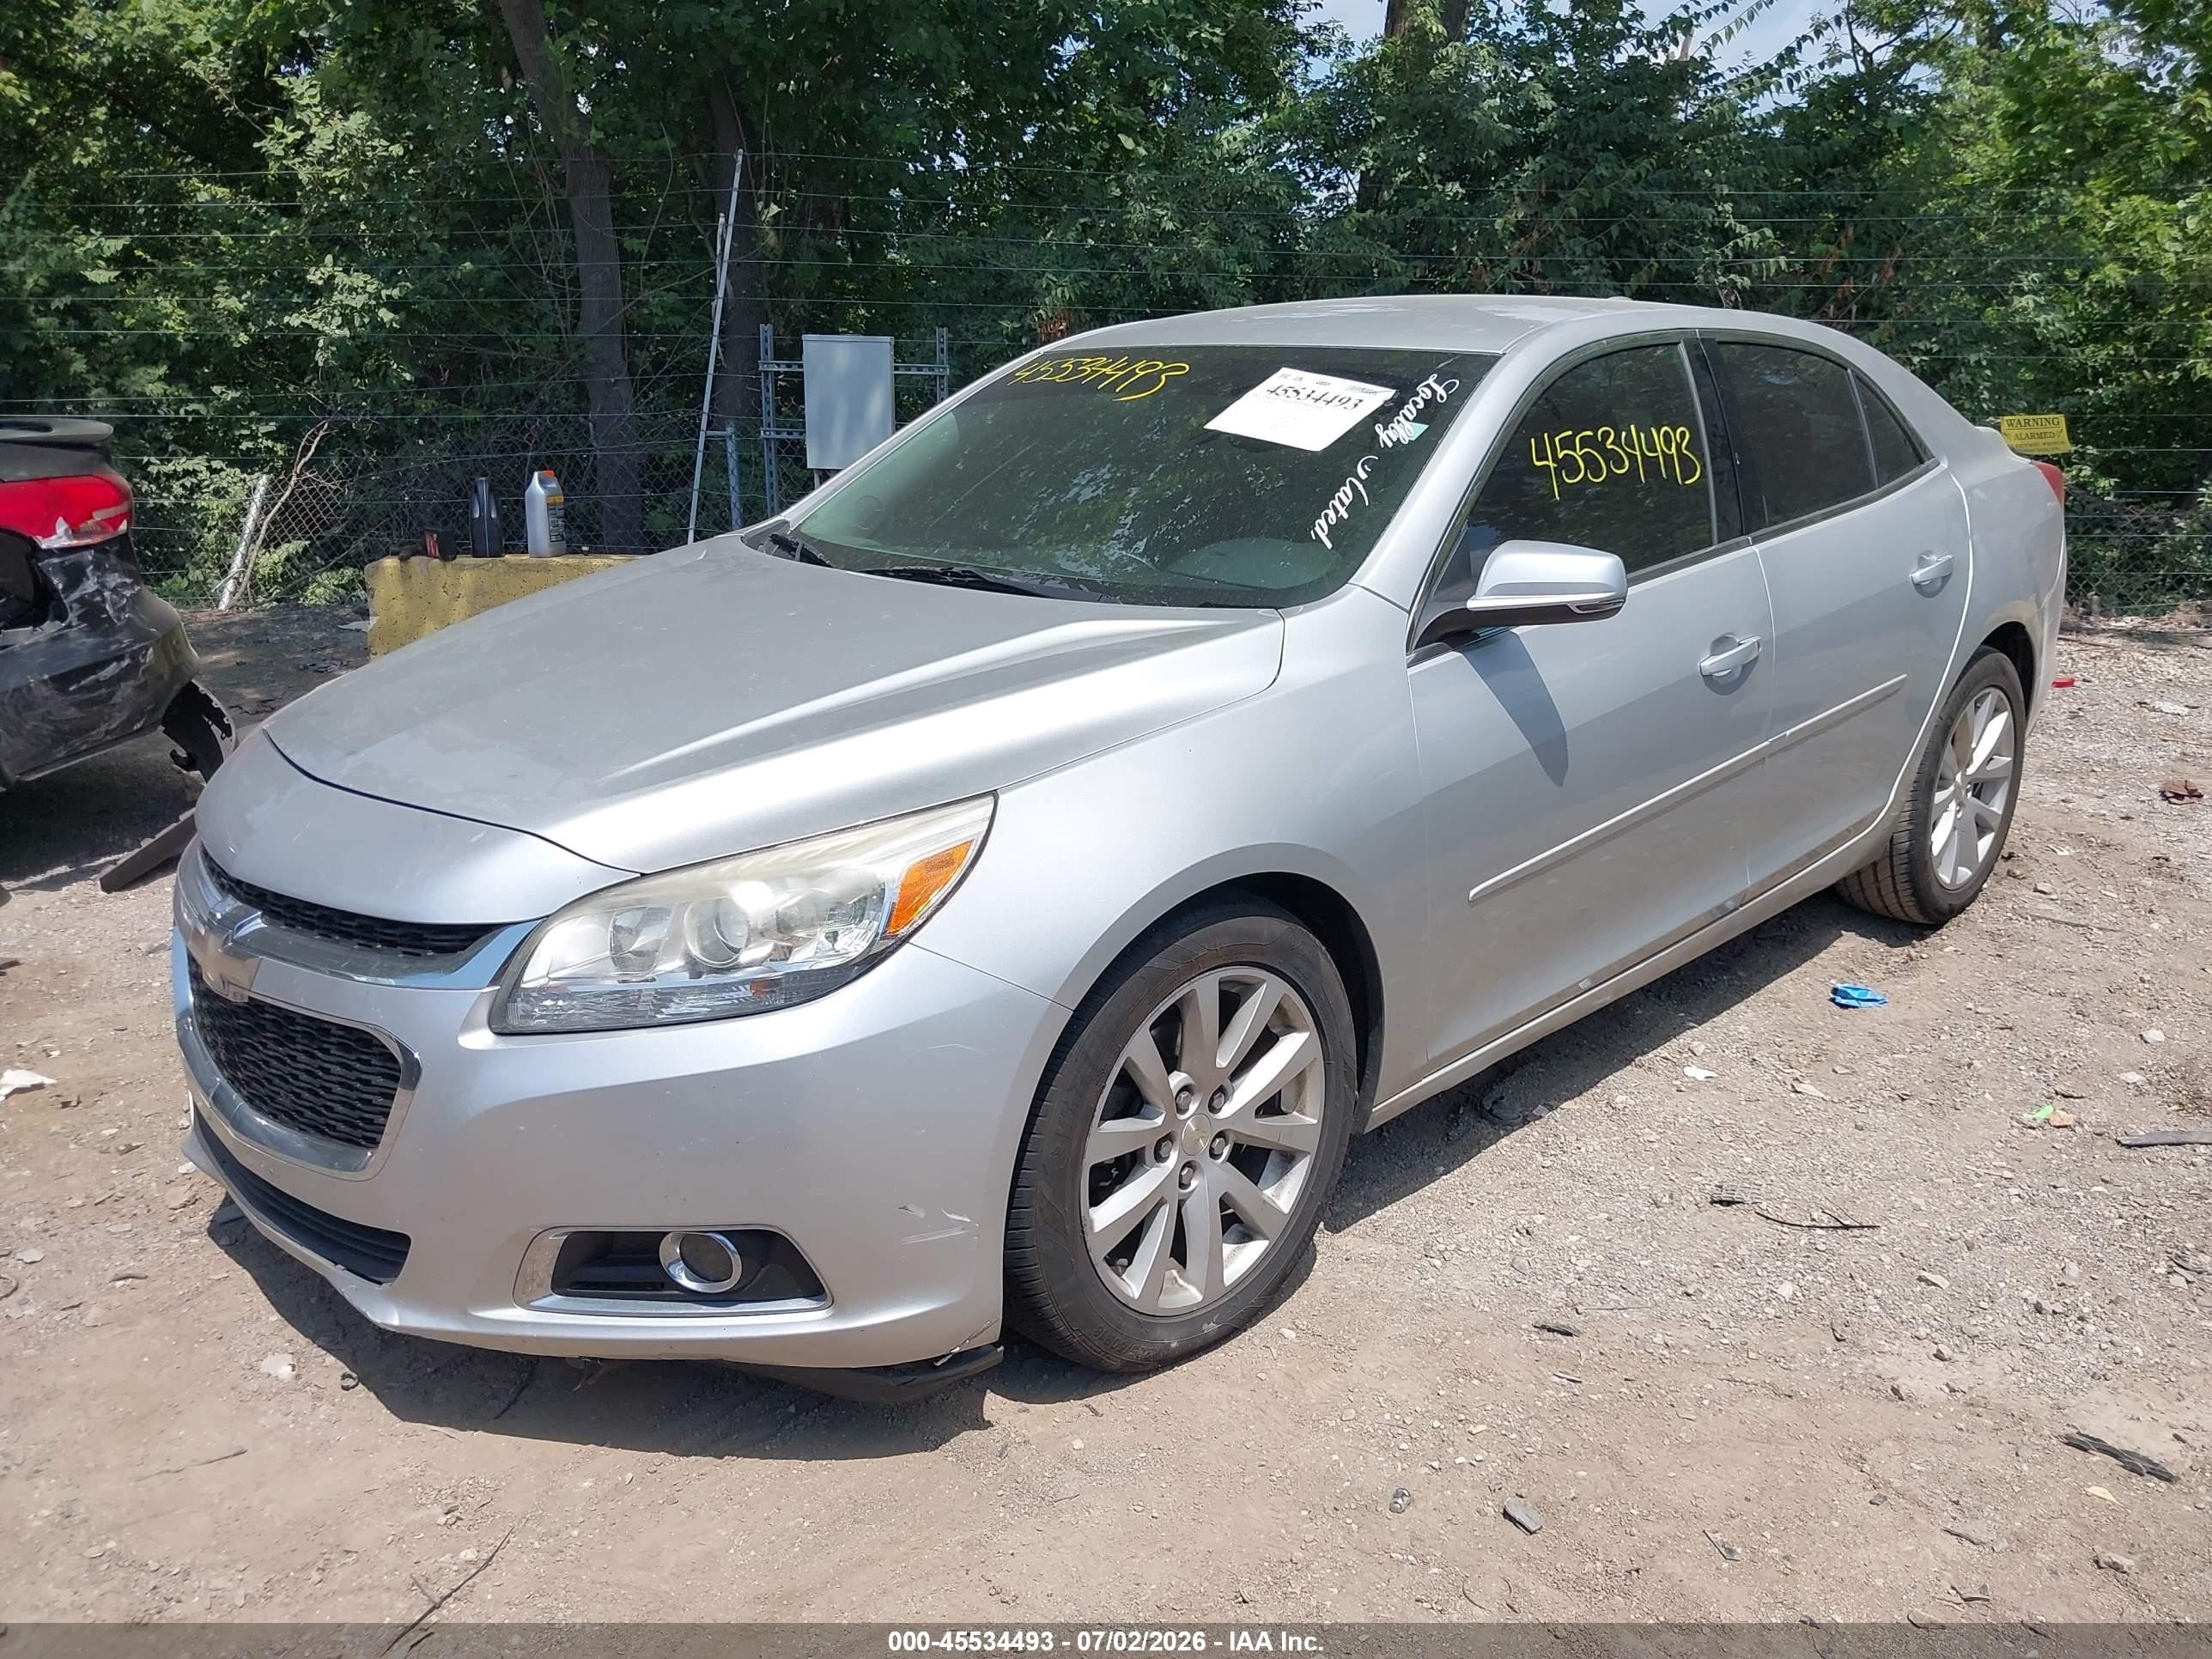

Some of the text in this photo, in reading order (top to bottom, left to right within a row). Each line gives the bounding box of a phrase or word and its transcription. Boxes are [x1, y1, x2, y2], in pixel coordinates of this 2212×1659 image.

[1006, 356, 1191, 402] 45534493
[1265, 384, 1364, 411] 45534493
[1376, 374, 1461, 449] Locally
[2007, 417, 2060, 428] WARNING
[1530, 423, 1703, 502] 45534493
